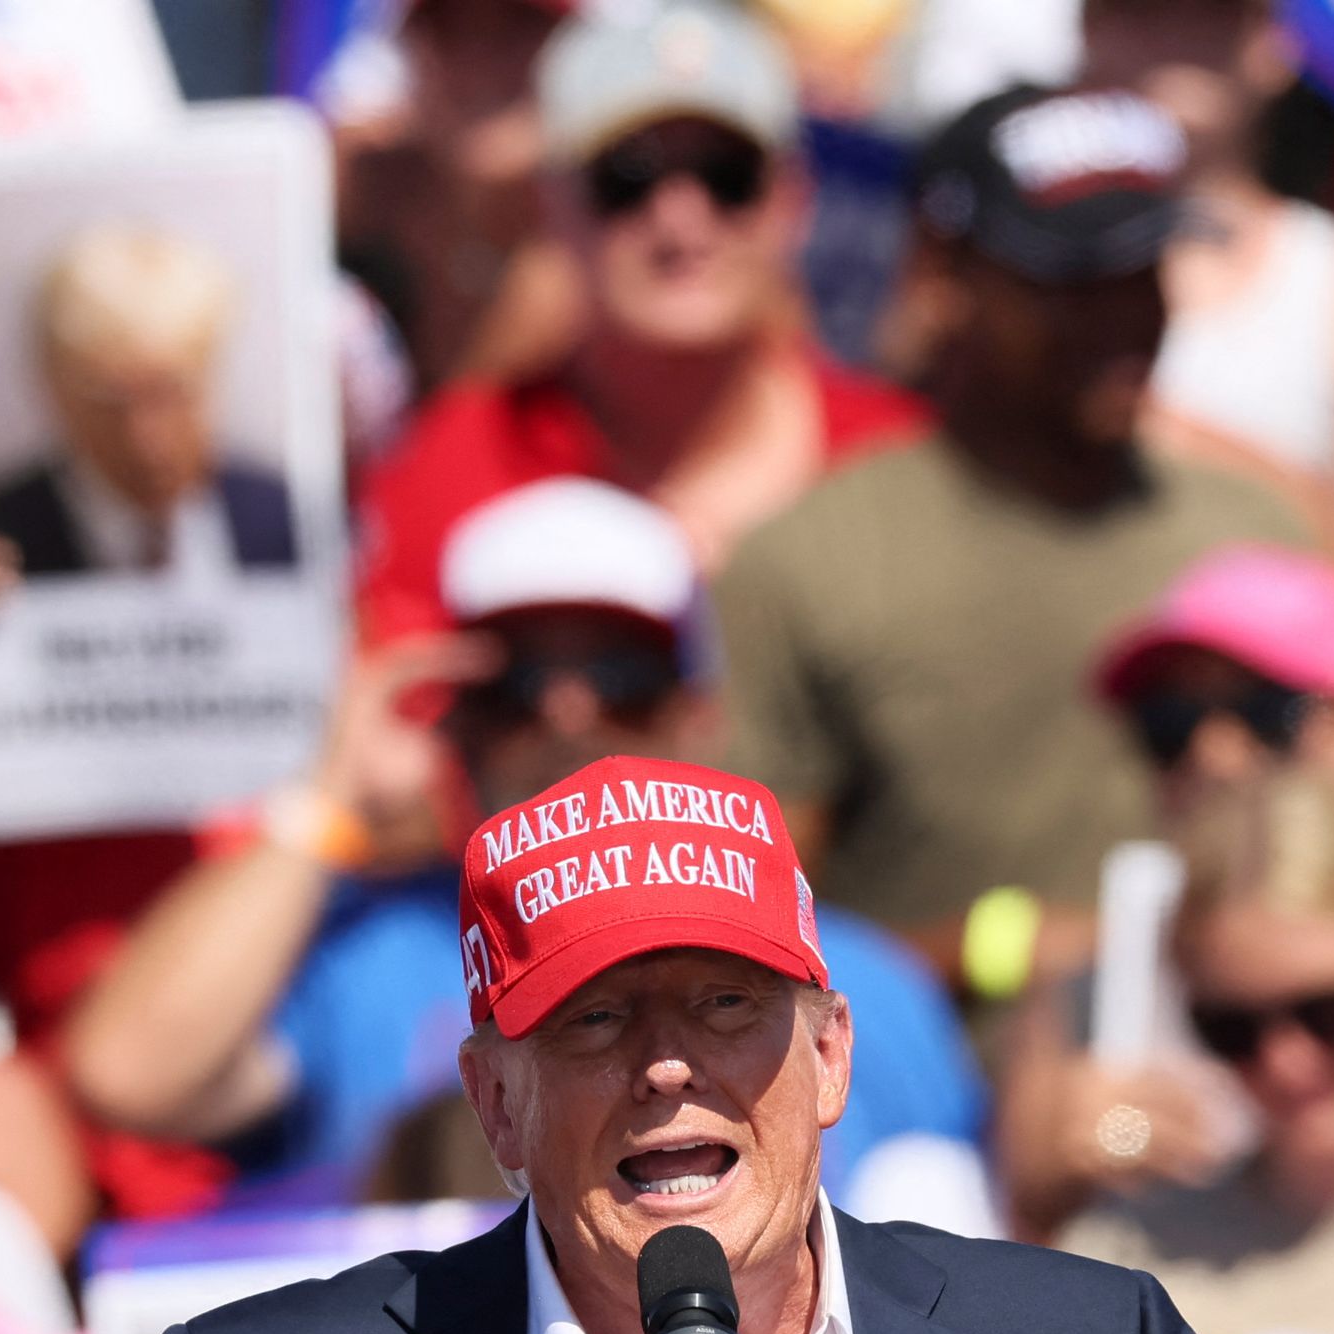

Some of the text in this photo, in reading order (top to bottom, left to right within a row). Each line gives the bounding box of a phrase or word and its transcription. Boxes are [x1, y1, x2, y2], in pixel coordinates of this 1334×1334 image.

[482, 780, 773, 874] MAKE AMERICA
[515, 842, 757, 924] GREAT AGAIN
